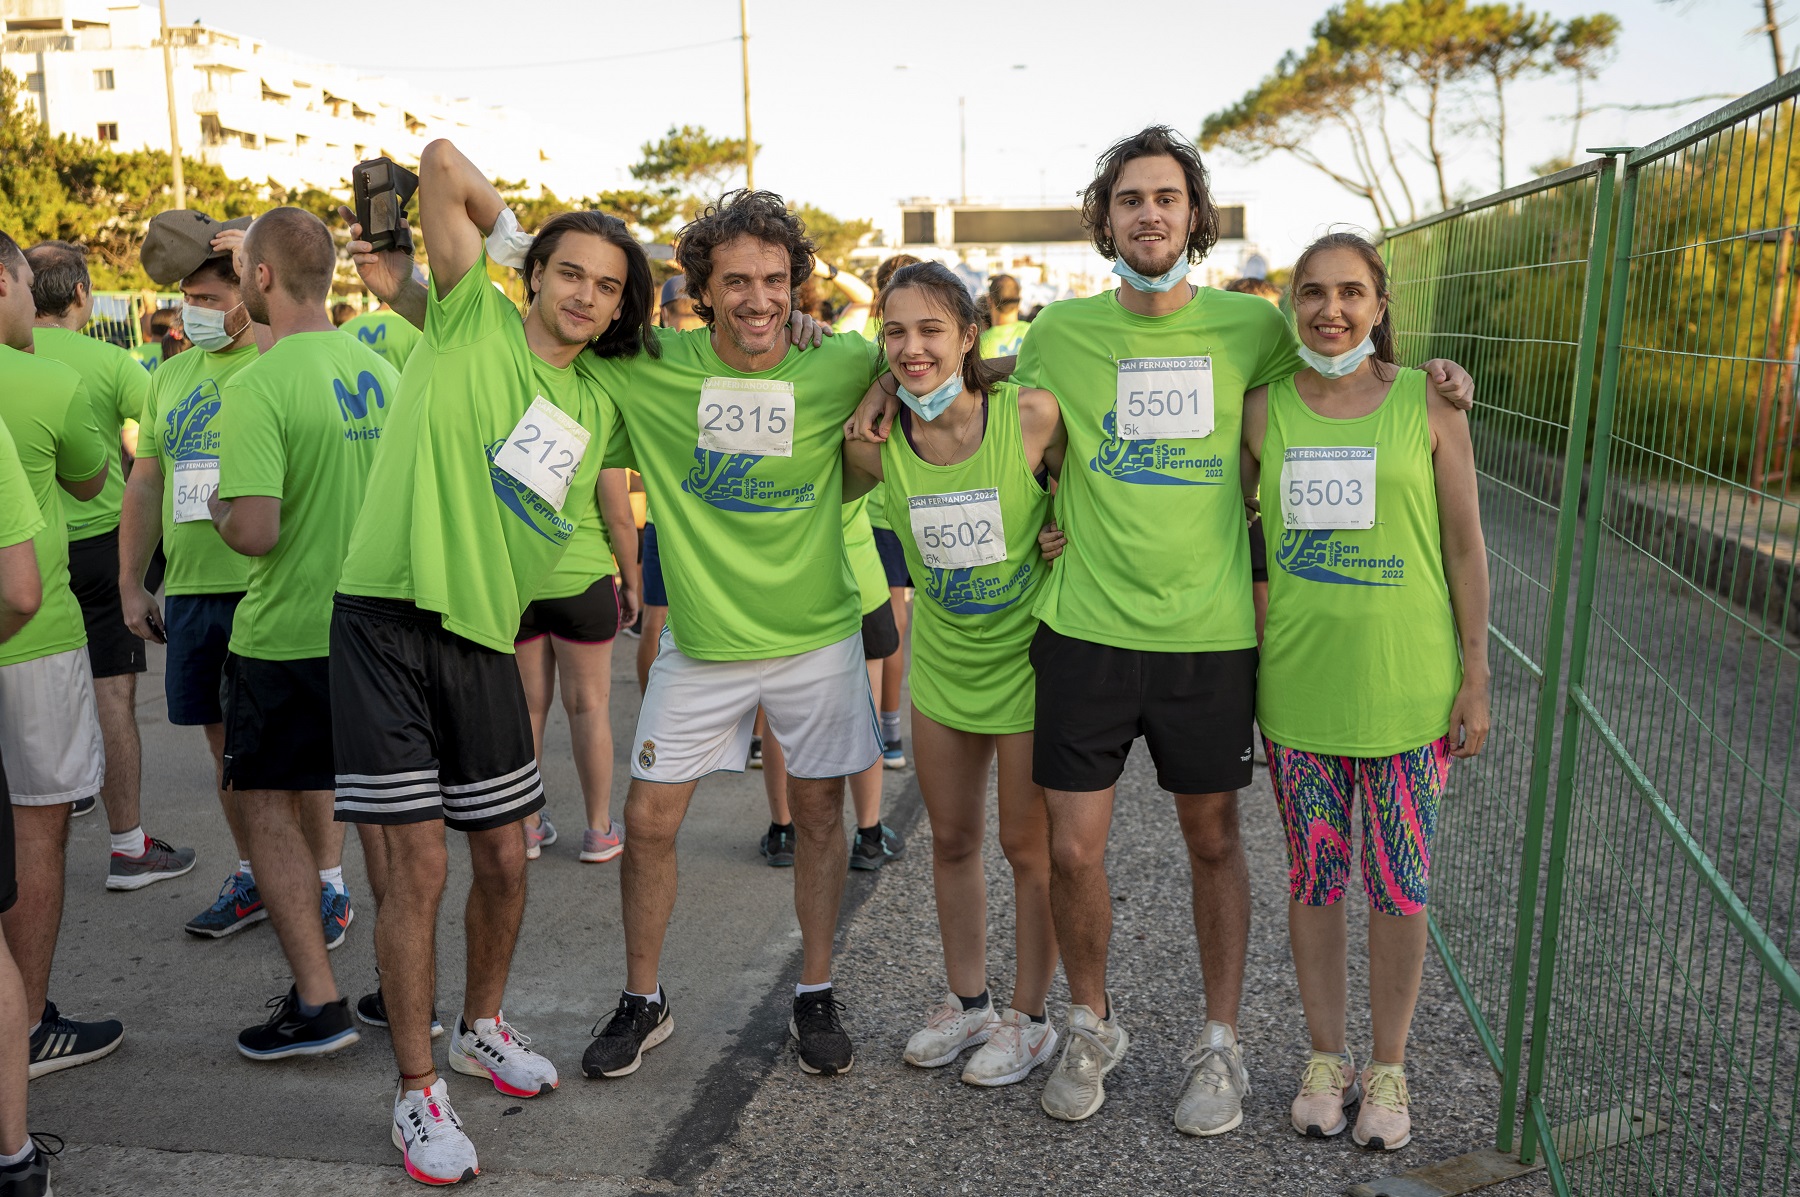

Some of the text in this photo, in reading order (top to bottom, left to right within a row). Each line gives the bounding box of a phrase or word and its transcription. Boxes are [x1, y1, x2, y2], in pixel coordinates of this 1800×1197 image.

[1120, 360, 1208, 370] SAN FERNANDO 2022
[722, 381, 770, 390] FERNANDO
[1128, 388, 1198, 417] 5501
[704, 403, 787, 434] 2315
[1124, 423, 1140, 436] 5k
[1161, 444, 1186, 456] San
[1284, 450, 1372, 459] SAN FERNANDO 2022
[186, 461, 218, 470] FERNANDO
[1161, 454, 1223, 469] Fernando
[1205, 469, 1223, 478] 2022
[750, 478, 775, 489] San
[750, 482, 814, 499] Fernando
[1289, 479, 1363, 506] 5503
[794, 493, 816, 503] 2022
[911, 491, 994, 507] SAN FERNANDO 2022
[1287, 512, 1299, 525] 5k
[923, 519, 993, 548] 5502
[1327, 541, 1335, 567] Corrida
[1334, 541, 1360, 554] San
[925, 554, 941, 564] 5k
[1333, 555, 1405, 568] Fernando
[1018, 571, 1033, 589] 202
[1381, 570, 1404, 579] 2022
[977, 577, 1001, 588] San
[980, 564, 1031, 599] Fernando
